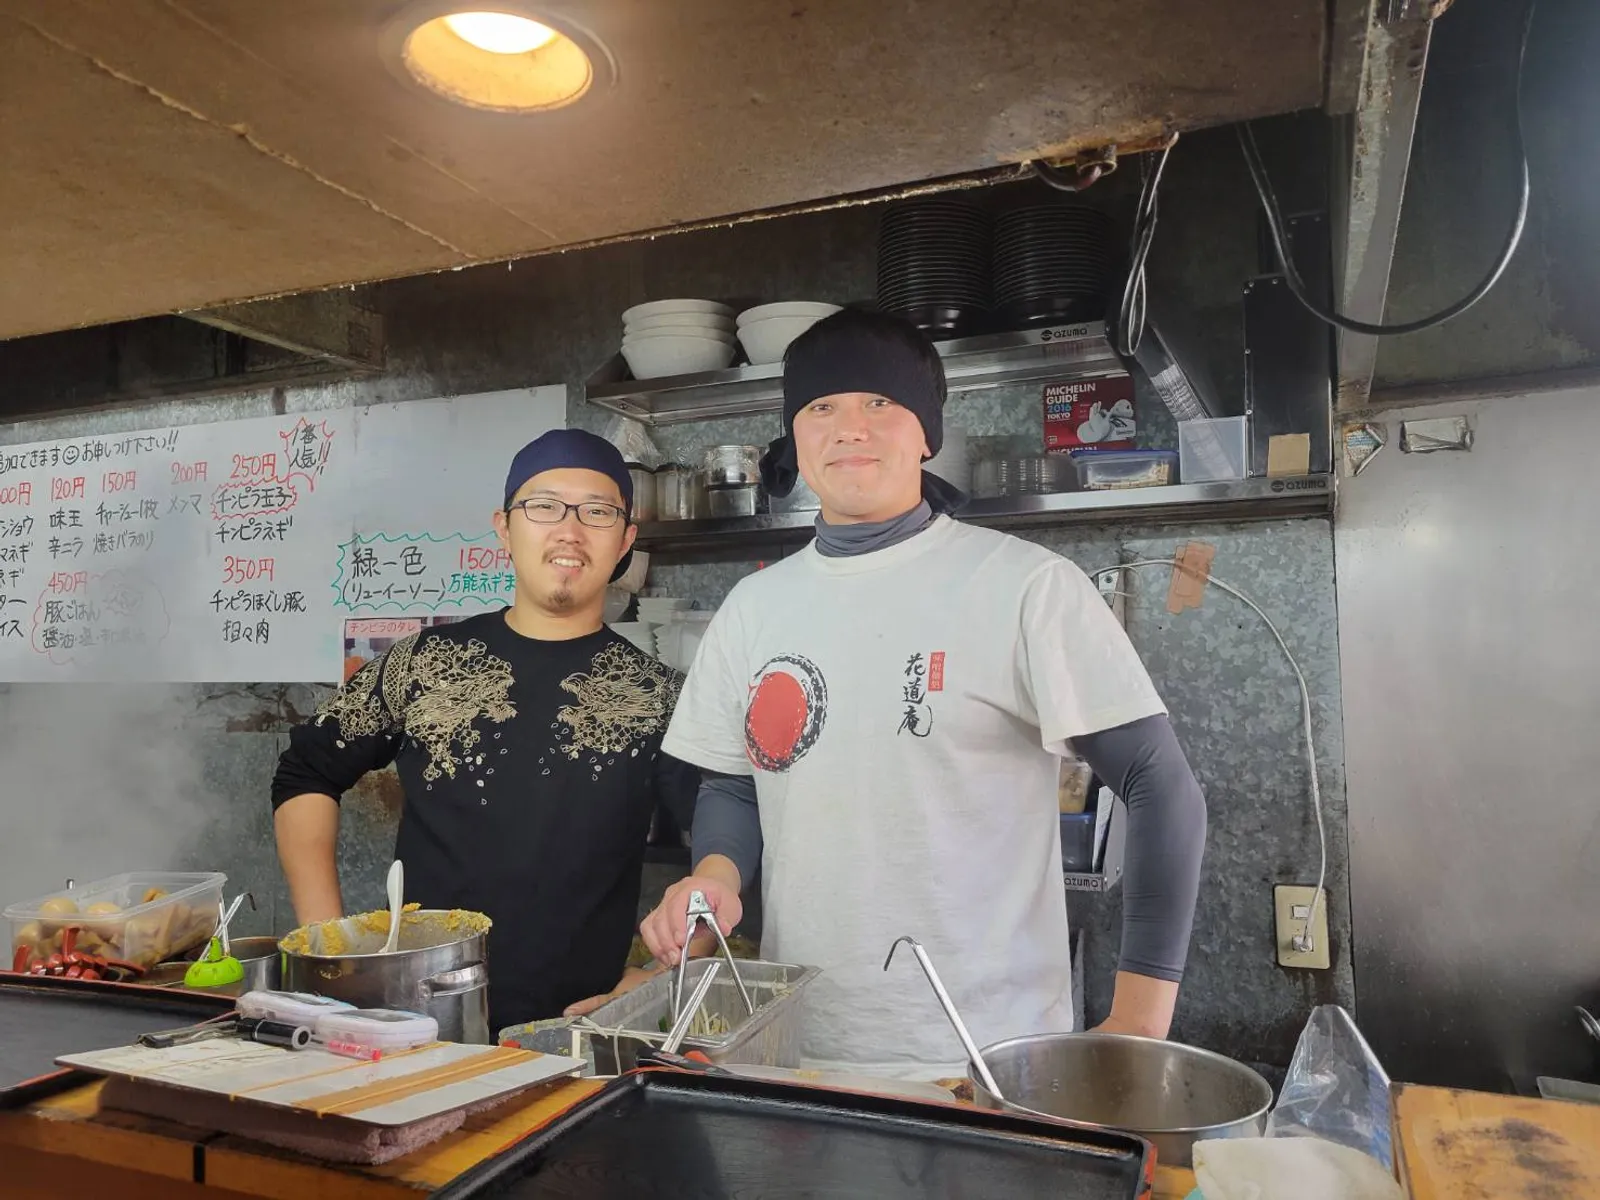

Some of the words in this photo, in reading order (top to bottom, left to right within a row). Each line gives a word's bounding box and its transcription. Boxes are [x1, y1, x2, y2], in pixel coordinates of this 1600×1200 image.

[1053, 328, 1088, 338] azuma
[1046, 383, 1096, 396] MICHELIN
[1046, 393, 1079, 405] GUIDE
[1047, 412, 1071, 421] TOKYO
[171, 462, 207, 485] 200円
[230, 454, 276, 478] 250円
[51, 476, 85, 501] 120円
[102, 471, 136, 493] 150円
[1286, 480, 1327, 490] azuma
[166, 494, 202, 515] メンマ
[216, 487, 292, 513] チンピラ玉子
[49, 506, 83, 530] 味玉
[216, 515, 293, 543] チンピラネギ
[48, 536, 83, 559] 辛ニラ
[223, 556, 274, 583] 350円
[351, 546, 427, 579] 緑一色
[48, 571, 87, 594] 450円
[44, 599, 101, 624] 豚ごはん
[222, 619, 269, 644] 担々肉
[896, 652, 934, 738] 花道庵
[1064, 877, 1099, 888] azuma
